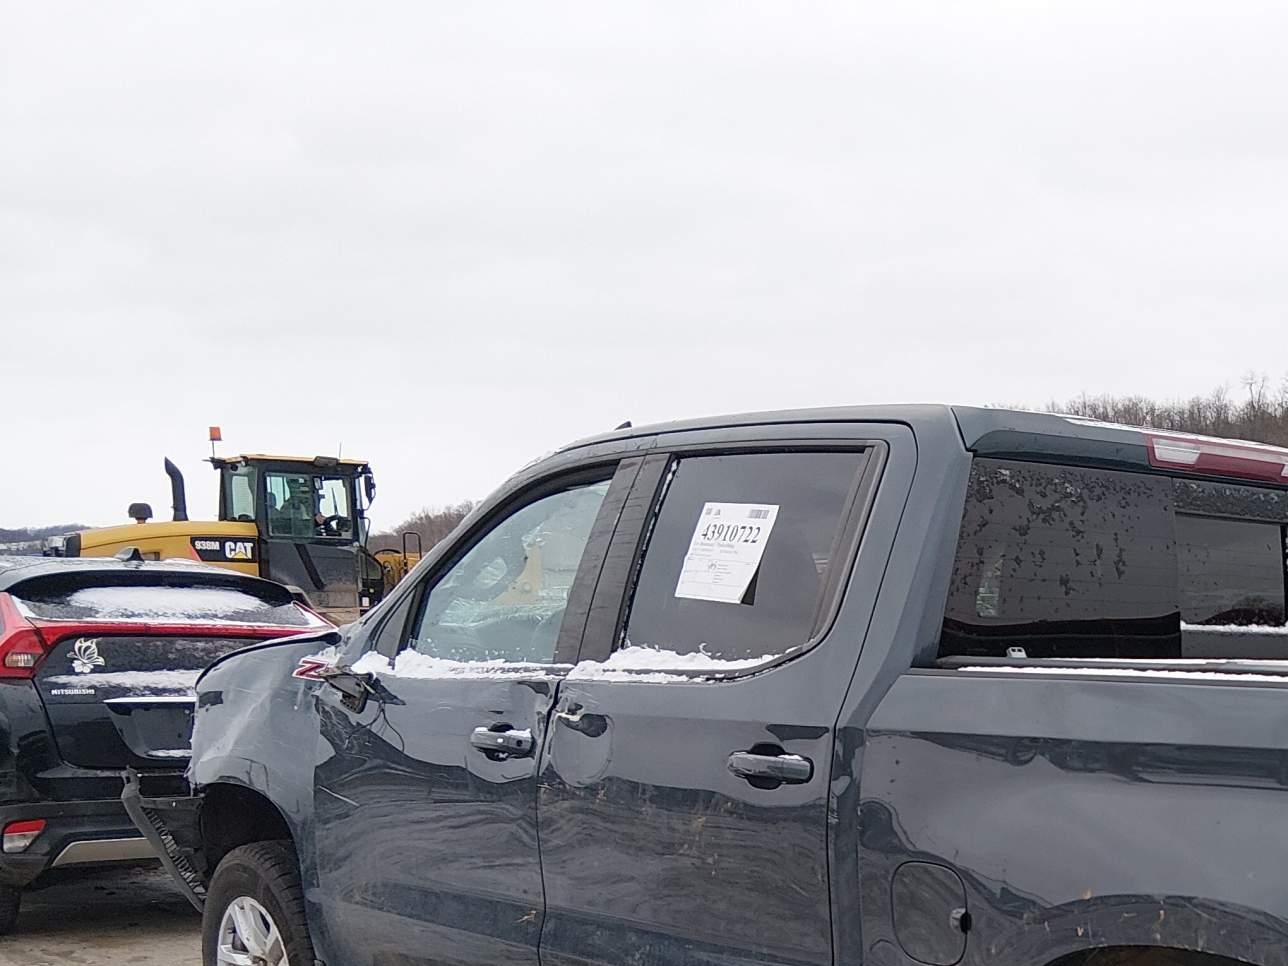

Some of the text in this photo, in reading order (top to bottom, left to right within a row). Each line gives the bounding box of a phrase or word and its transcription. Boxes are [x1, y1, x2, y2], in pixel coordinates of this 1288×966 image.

[701, 524, 761, 543] 43910722
[224, 541, 254, 559] CAT
[51, 688, 95, 696] MITSUBISHI
